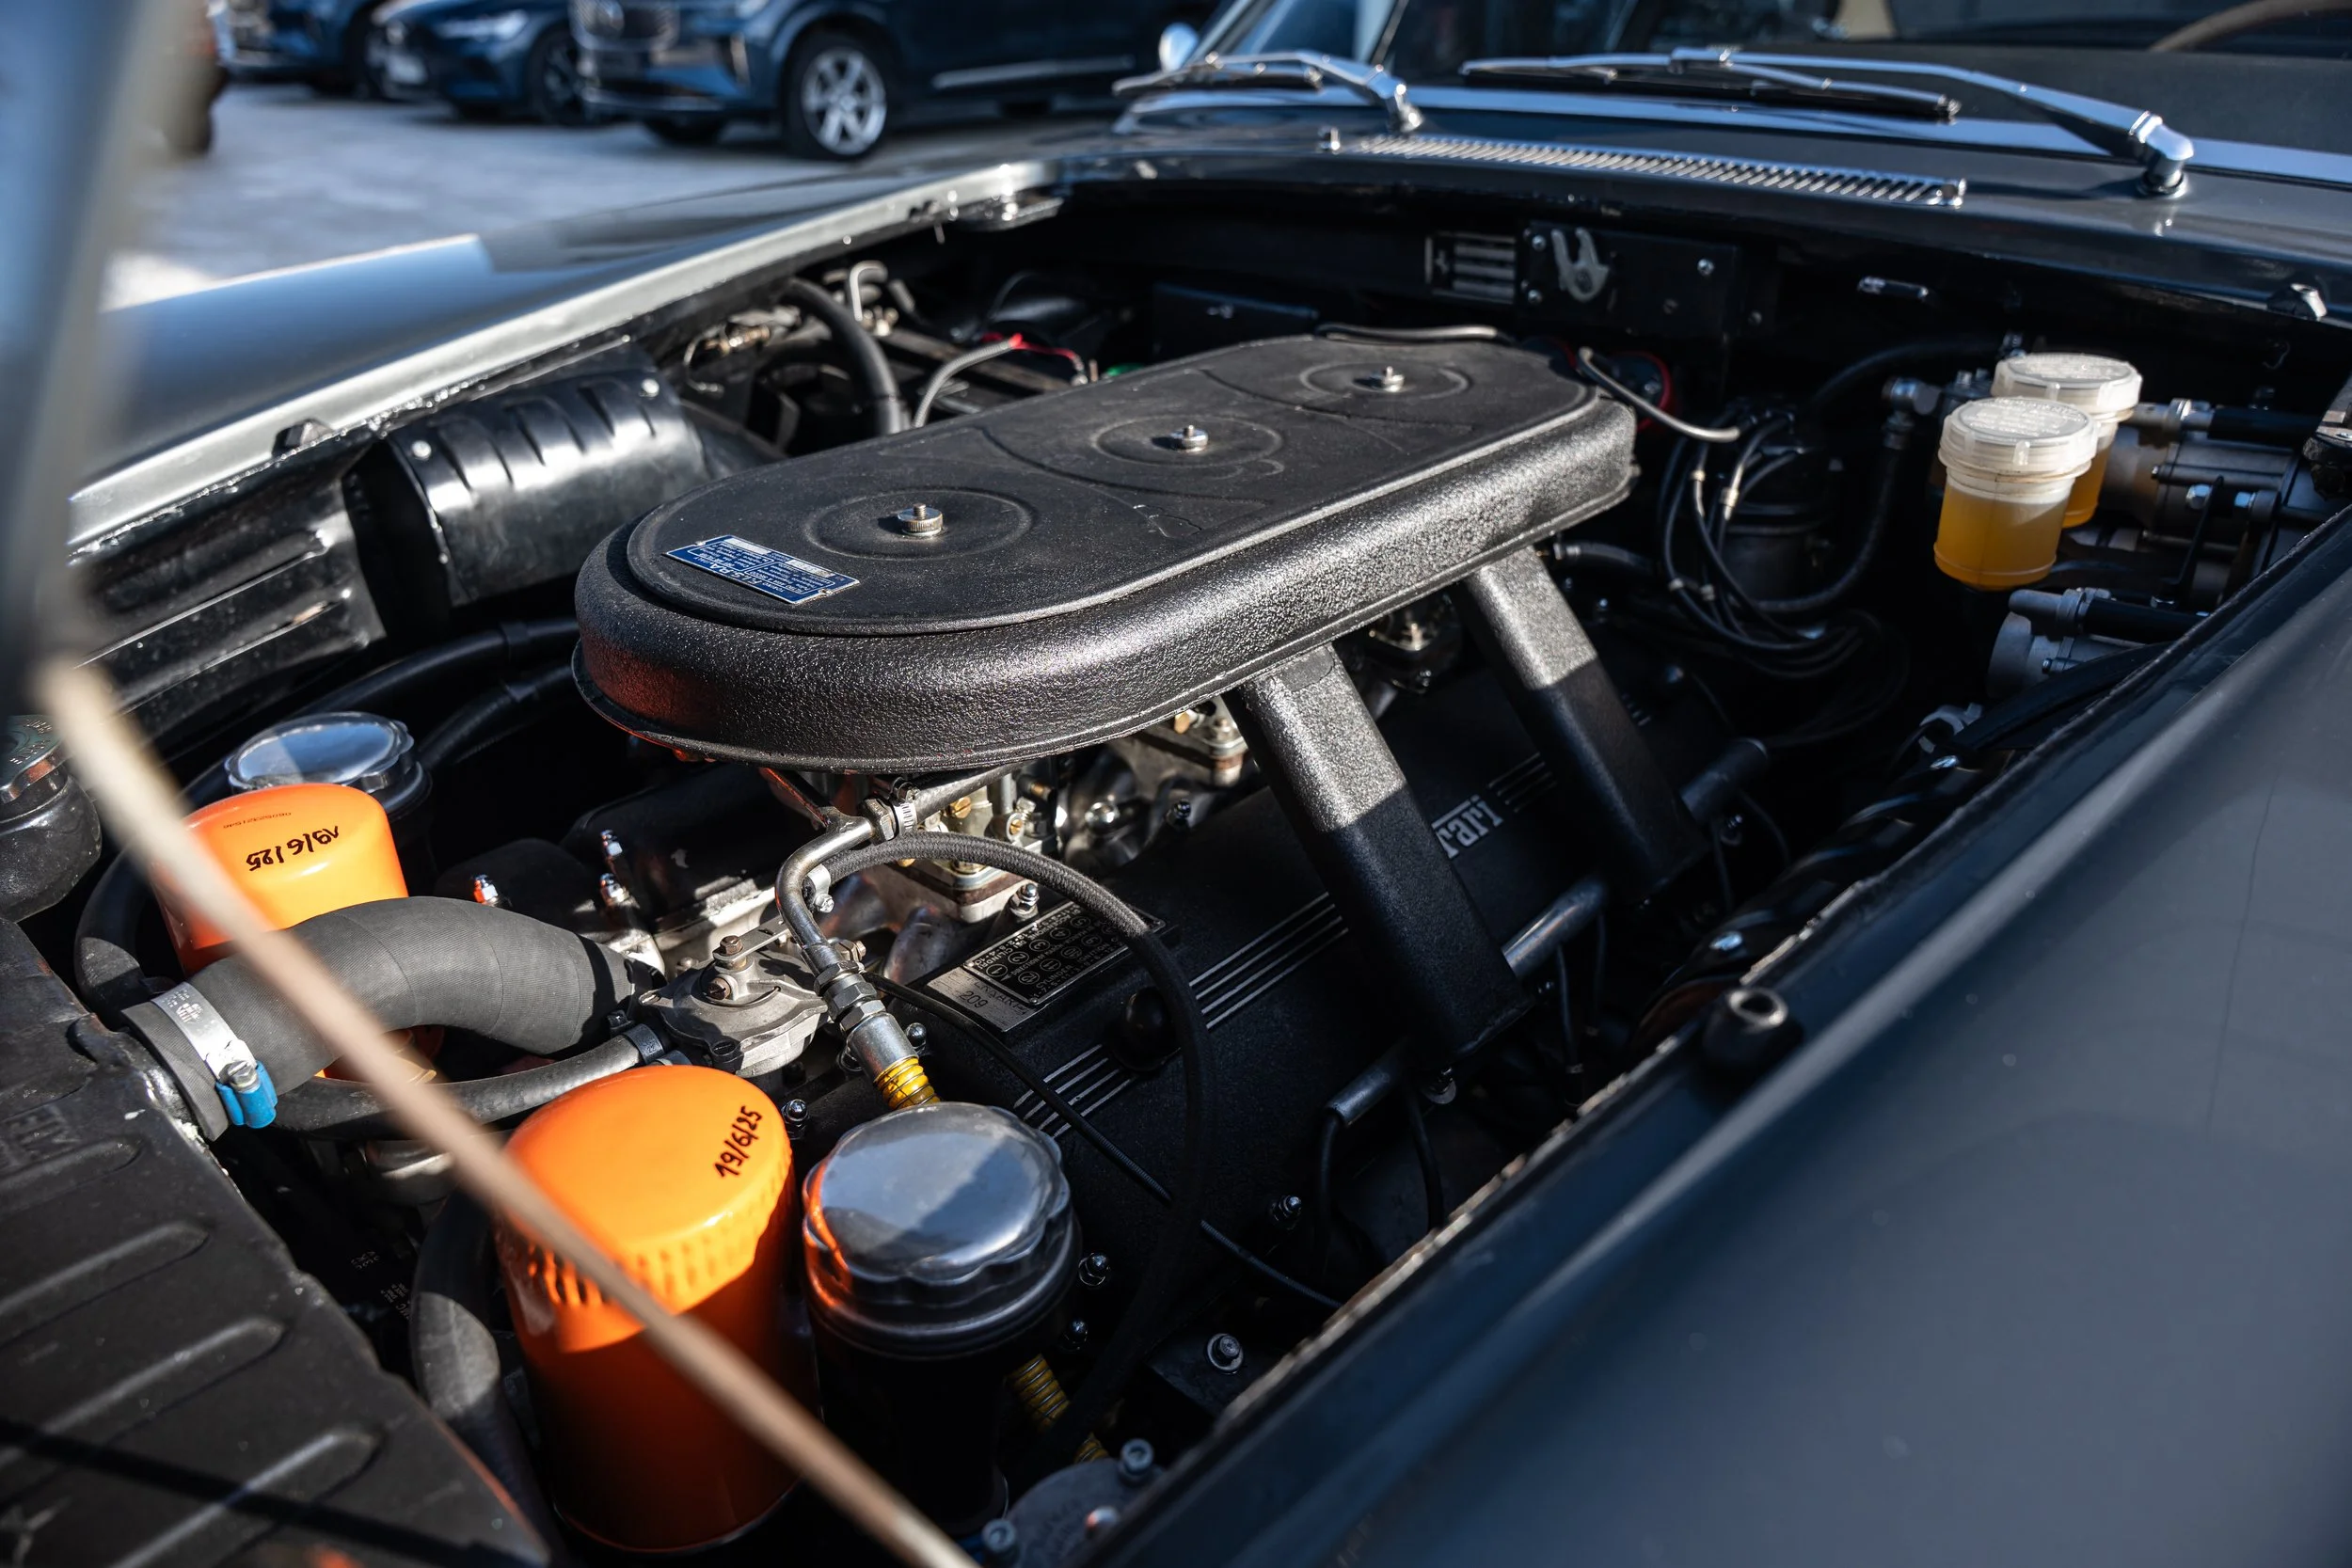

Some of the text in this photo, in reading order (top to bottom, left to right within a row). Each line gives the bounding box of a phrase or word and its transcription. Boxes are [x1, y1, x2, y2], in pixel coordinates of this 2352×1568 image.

[246, 825, 340, 872] 19/6/25
[977, 947, 1013, 970] CILINDRI
[958, 989, 989, 1010] 209
[713, 1104, 763, 1179] 19/6/25
